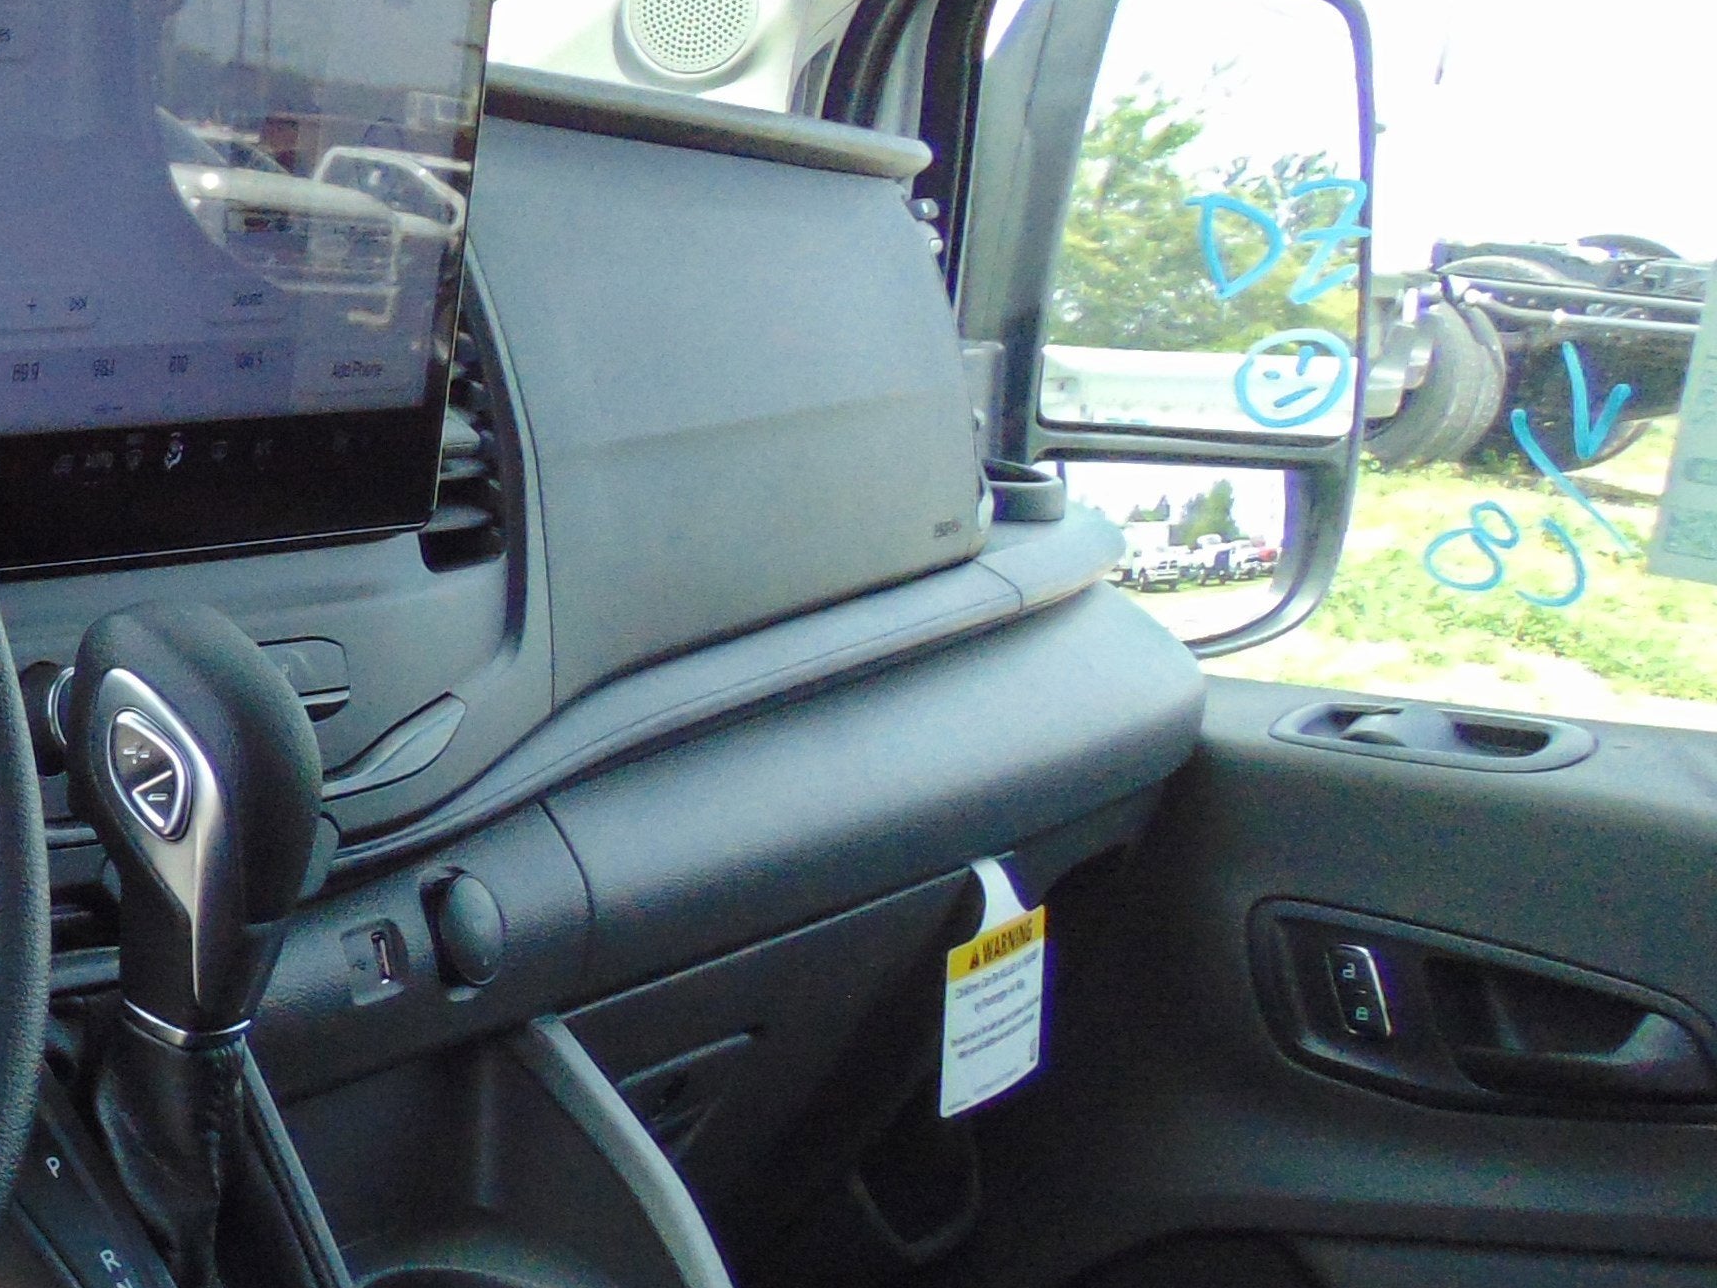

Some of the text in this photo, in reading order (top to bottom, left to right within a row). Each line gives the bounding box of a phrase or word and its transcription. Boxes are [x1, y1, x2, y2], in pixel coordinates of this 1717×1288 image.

[982, 917, 1034, 965] WARNING
[45, 1156, 61, 1179] P
[99, 1249, 122, 1274] R
